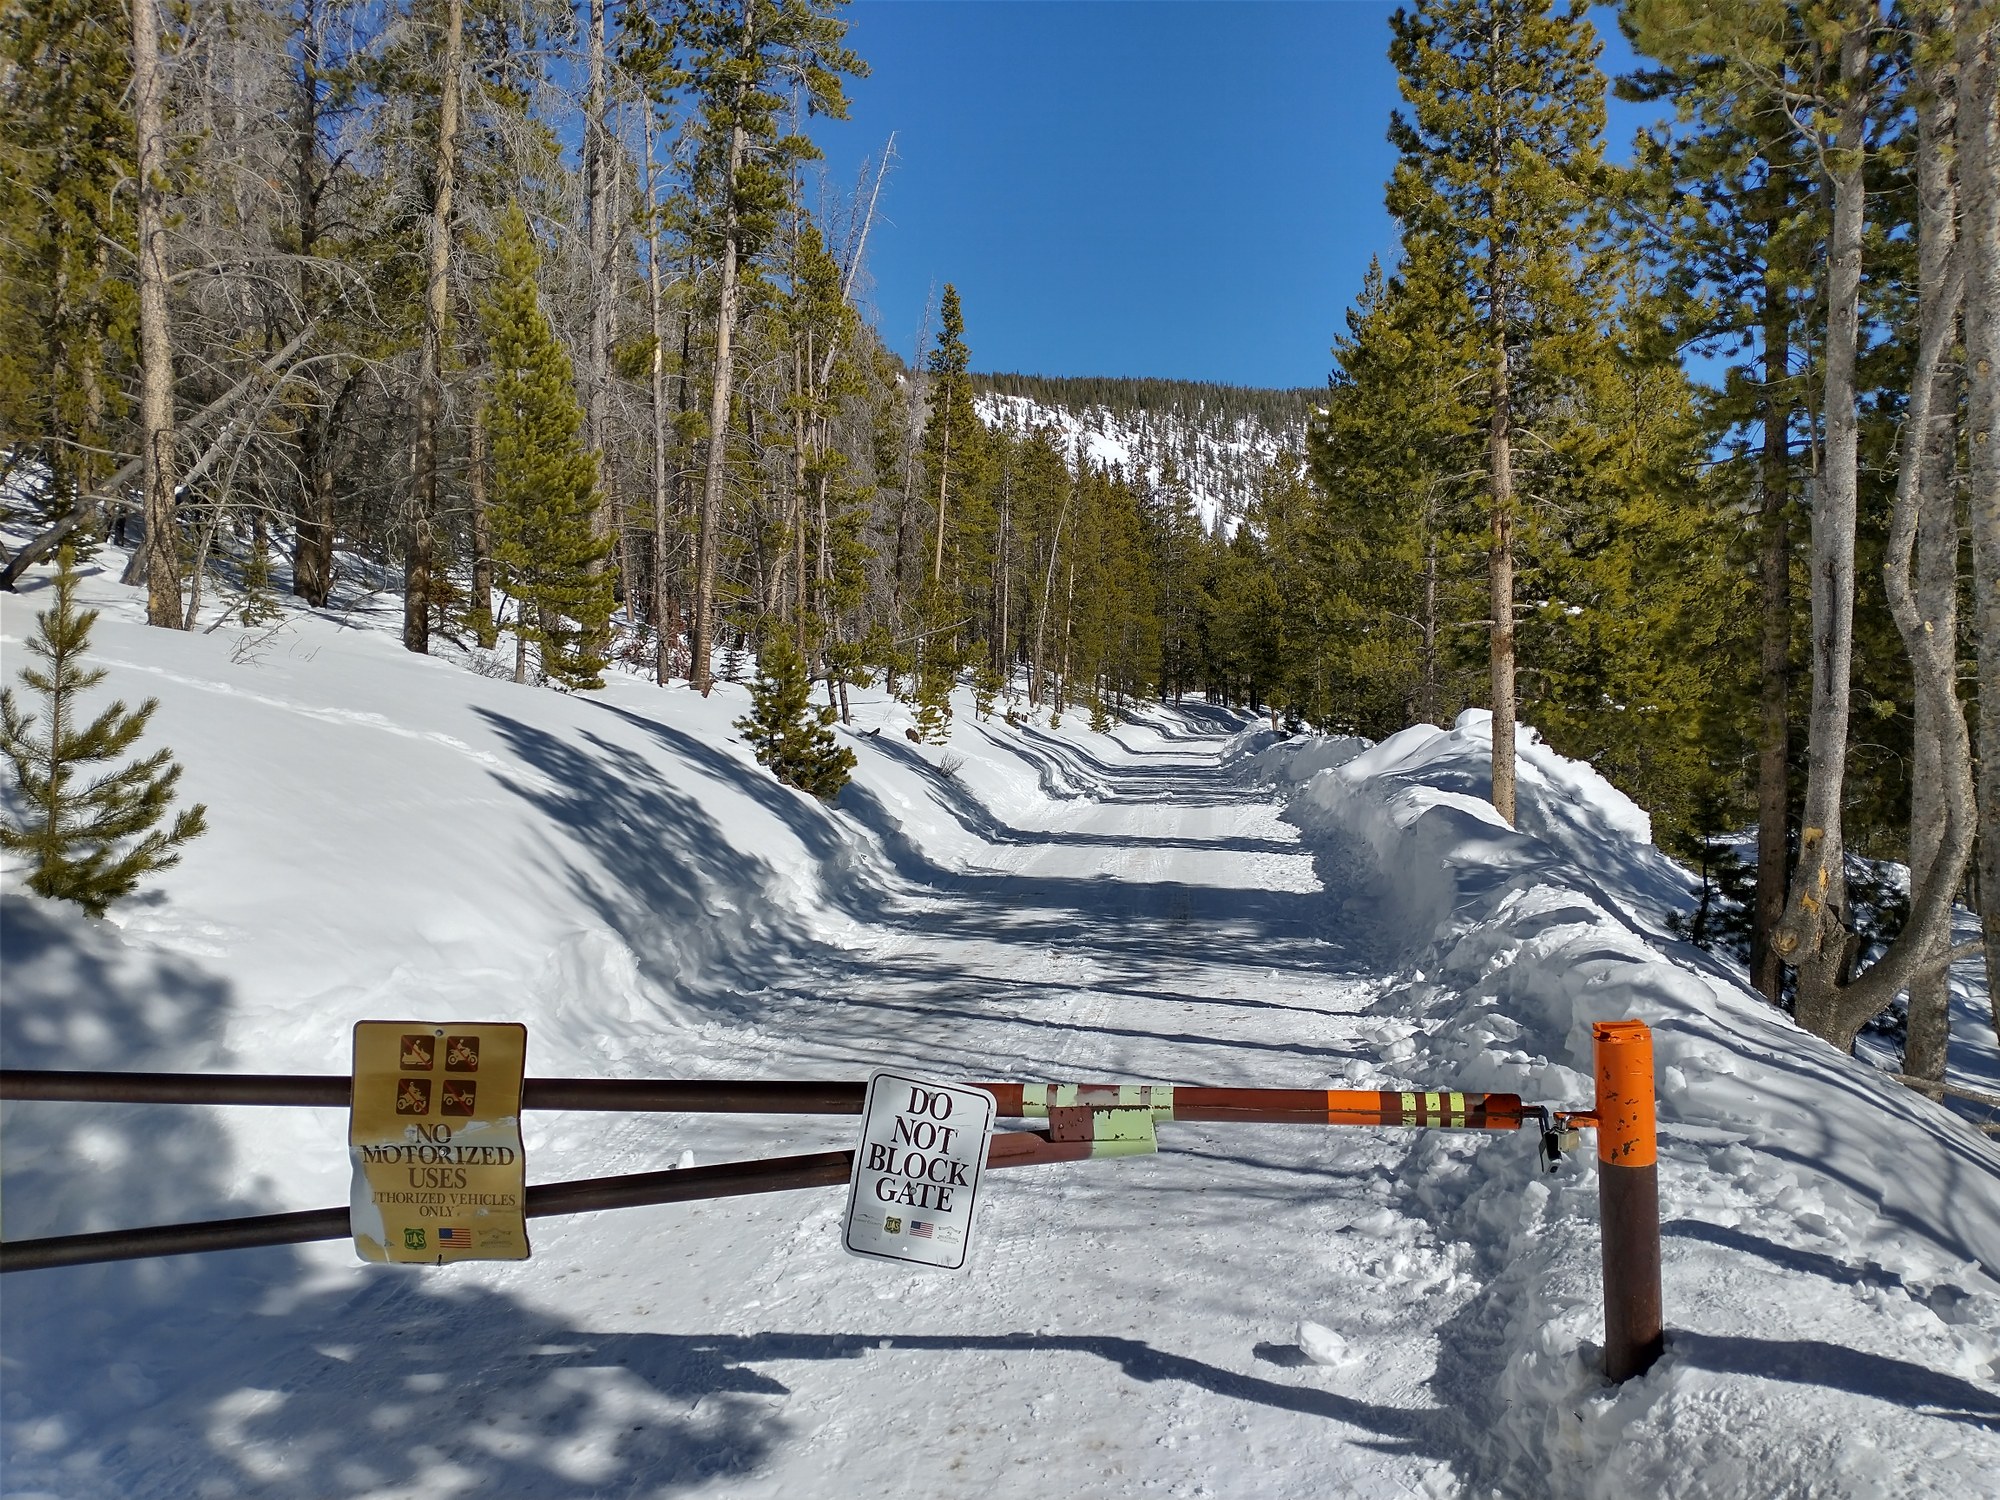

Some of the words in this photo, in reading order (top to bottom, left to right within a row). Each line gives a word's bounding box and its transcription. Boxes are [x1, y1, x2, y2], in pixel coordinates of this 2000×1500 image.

[906, 1086, 953, 1121] DO
[415, 1123, 452, 1144] NO
[890, 1115, 959, 1155] NOT
[361, 1145, 515, 1166] MOTORIZED
[866, 1142, 969, 1187] BLOCK
[409, 1167, 467, 1189] USES
[450, 1193, 516, 1207] VEHICLES
[875, 1177, 954, 1213] GATE
[419, 1206, 455, 1217] ONLY
